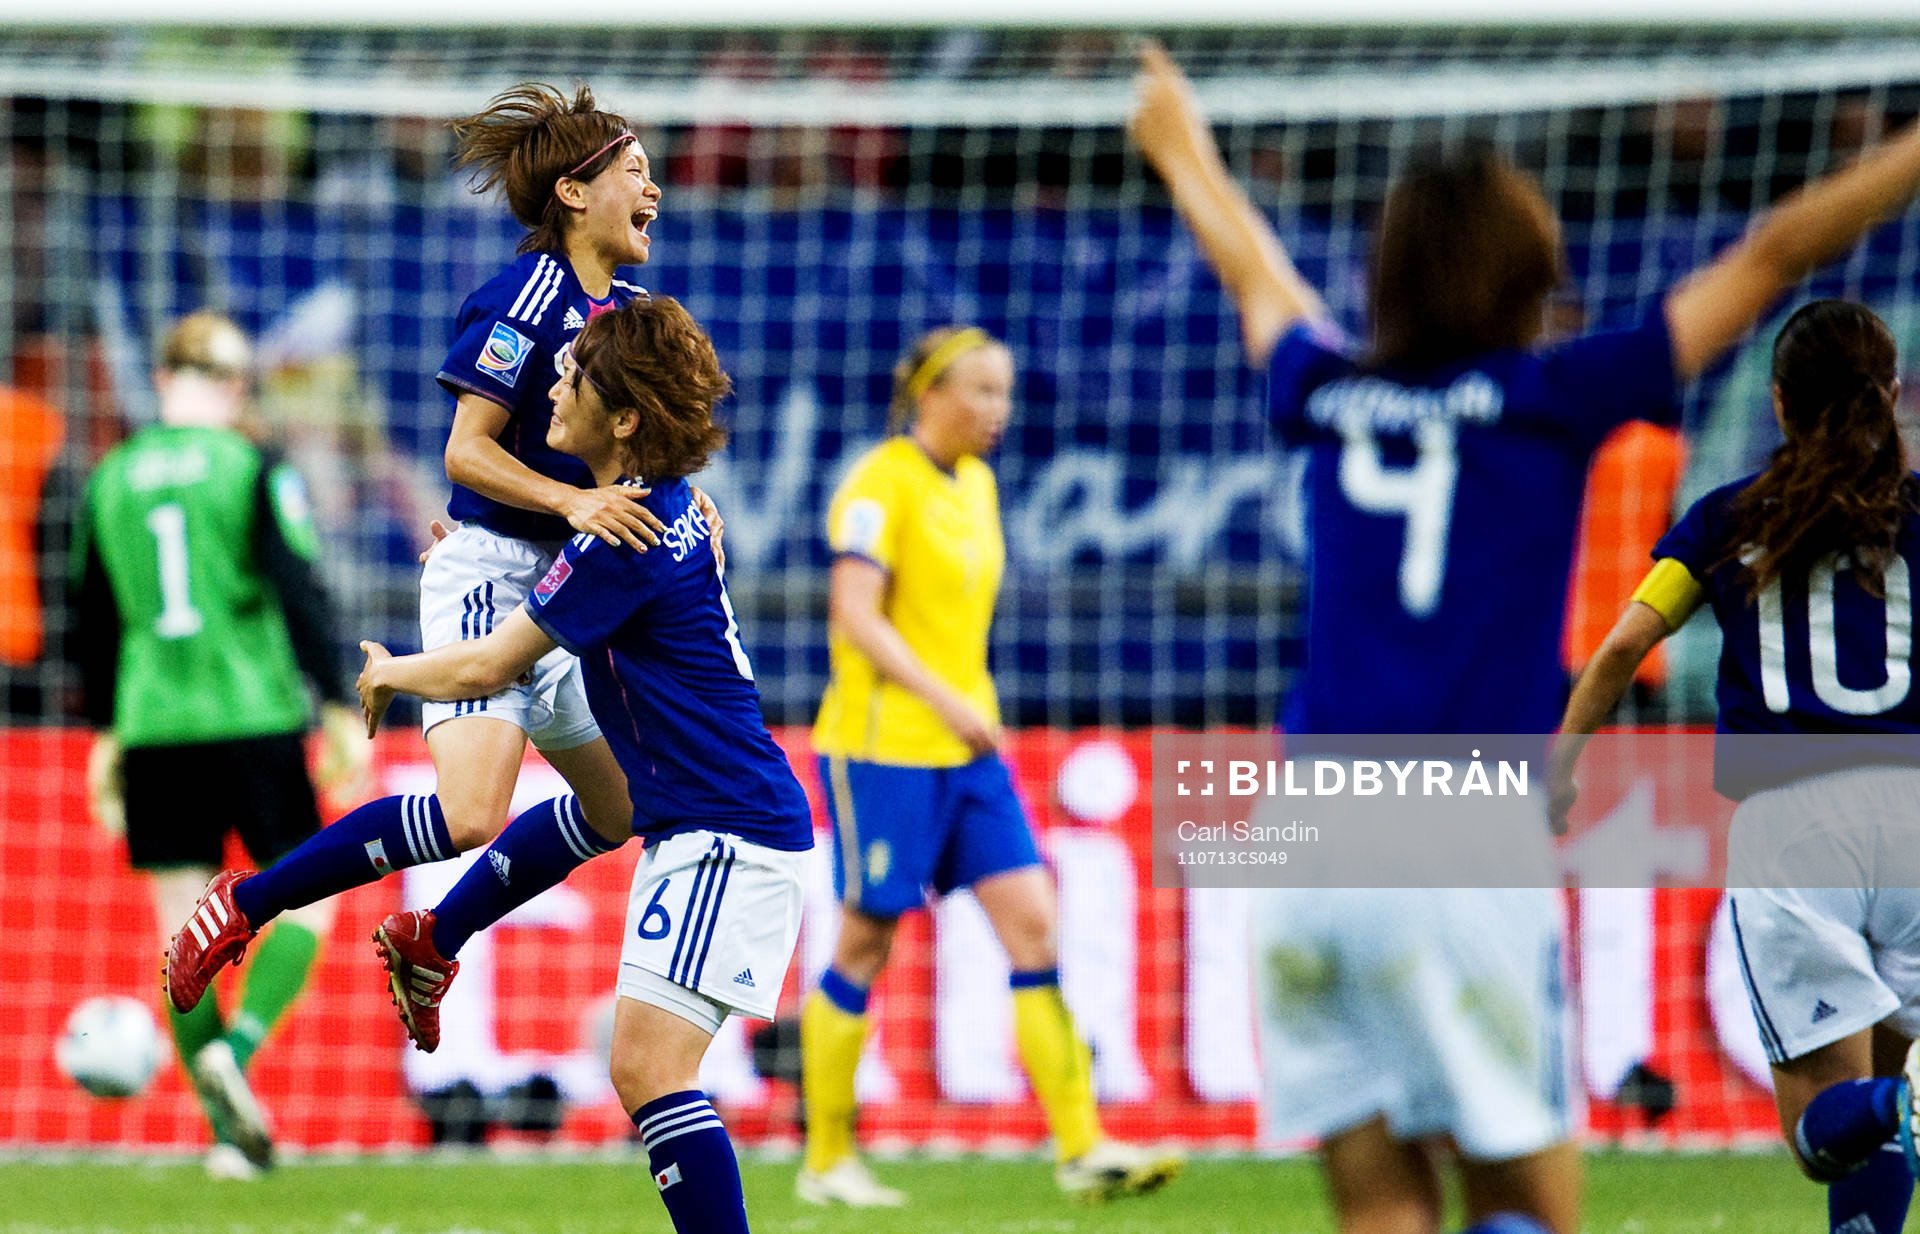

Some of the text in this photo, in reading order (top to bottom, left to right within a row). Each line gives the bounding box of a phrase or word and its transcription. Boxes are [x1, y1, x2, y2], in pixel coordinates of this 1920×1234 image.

[147, 503, 203, 638] 1
[1739, 541, 1912, 716] 10
[638, 878, 671, 940] 6
